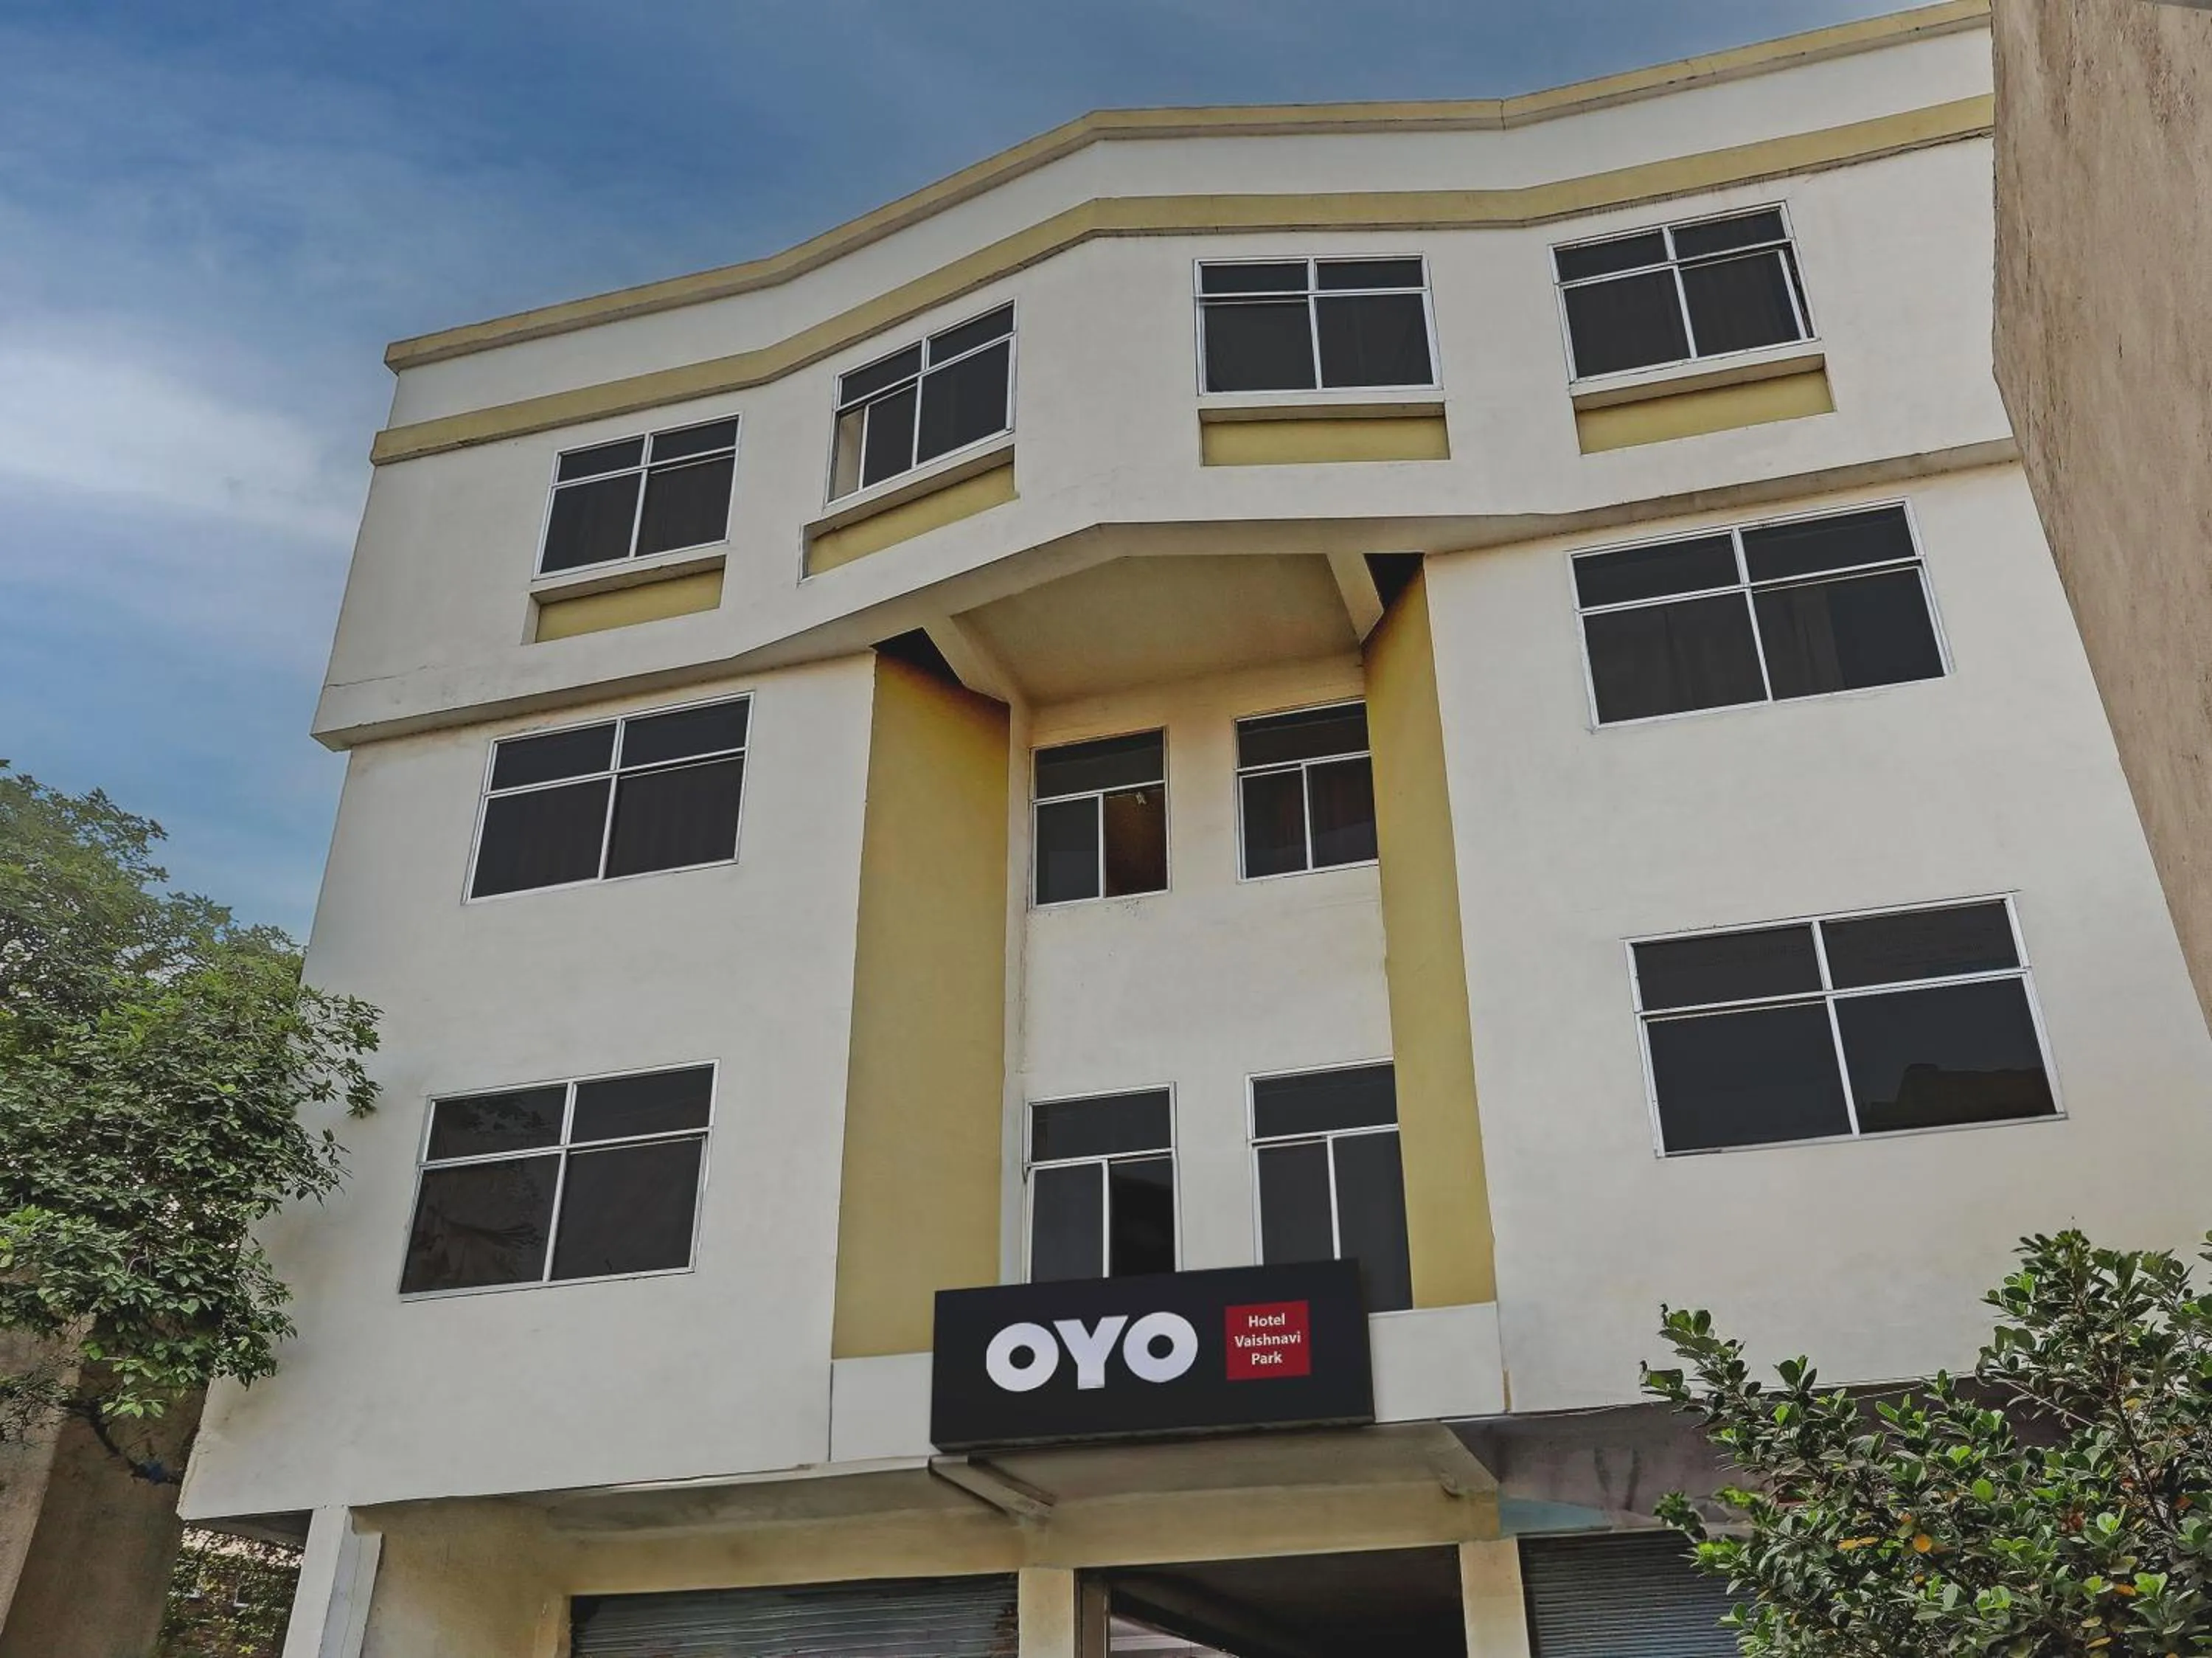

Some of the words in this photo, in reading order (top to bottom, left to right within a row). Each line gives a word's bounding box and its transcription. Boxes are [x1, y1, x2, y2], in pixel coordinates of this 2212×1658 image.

[1248, 1313, 1285, 1328] Hotel
[1234, 1331, 1301, 1347] Vaishnavi
[986, 1311, 1198, 1392] OYO
[1251, 1351, 1282, 1365] Park
